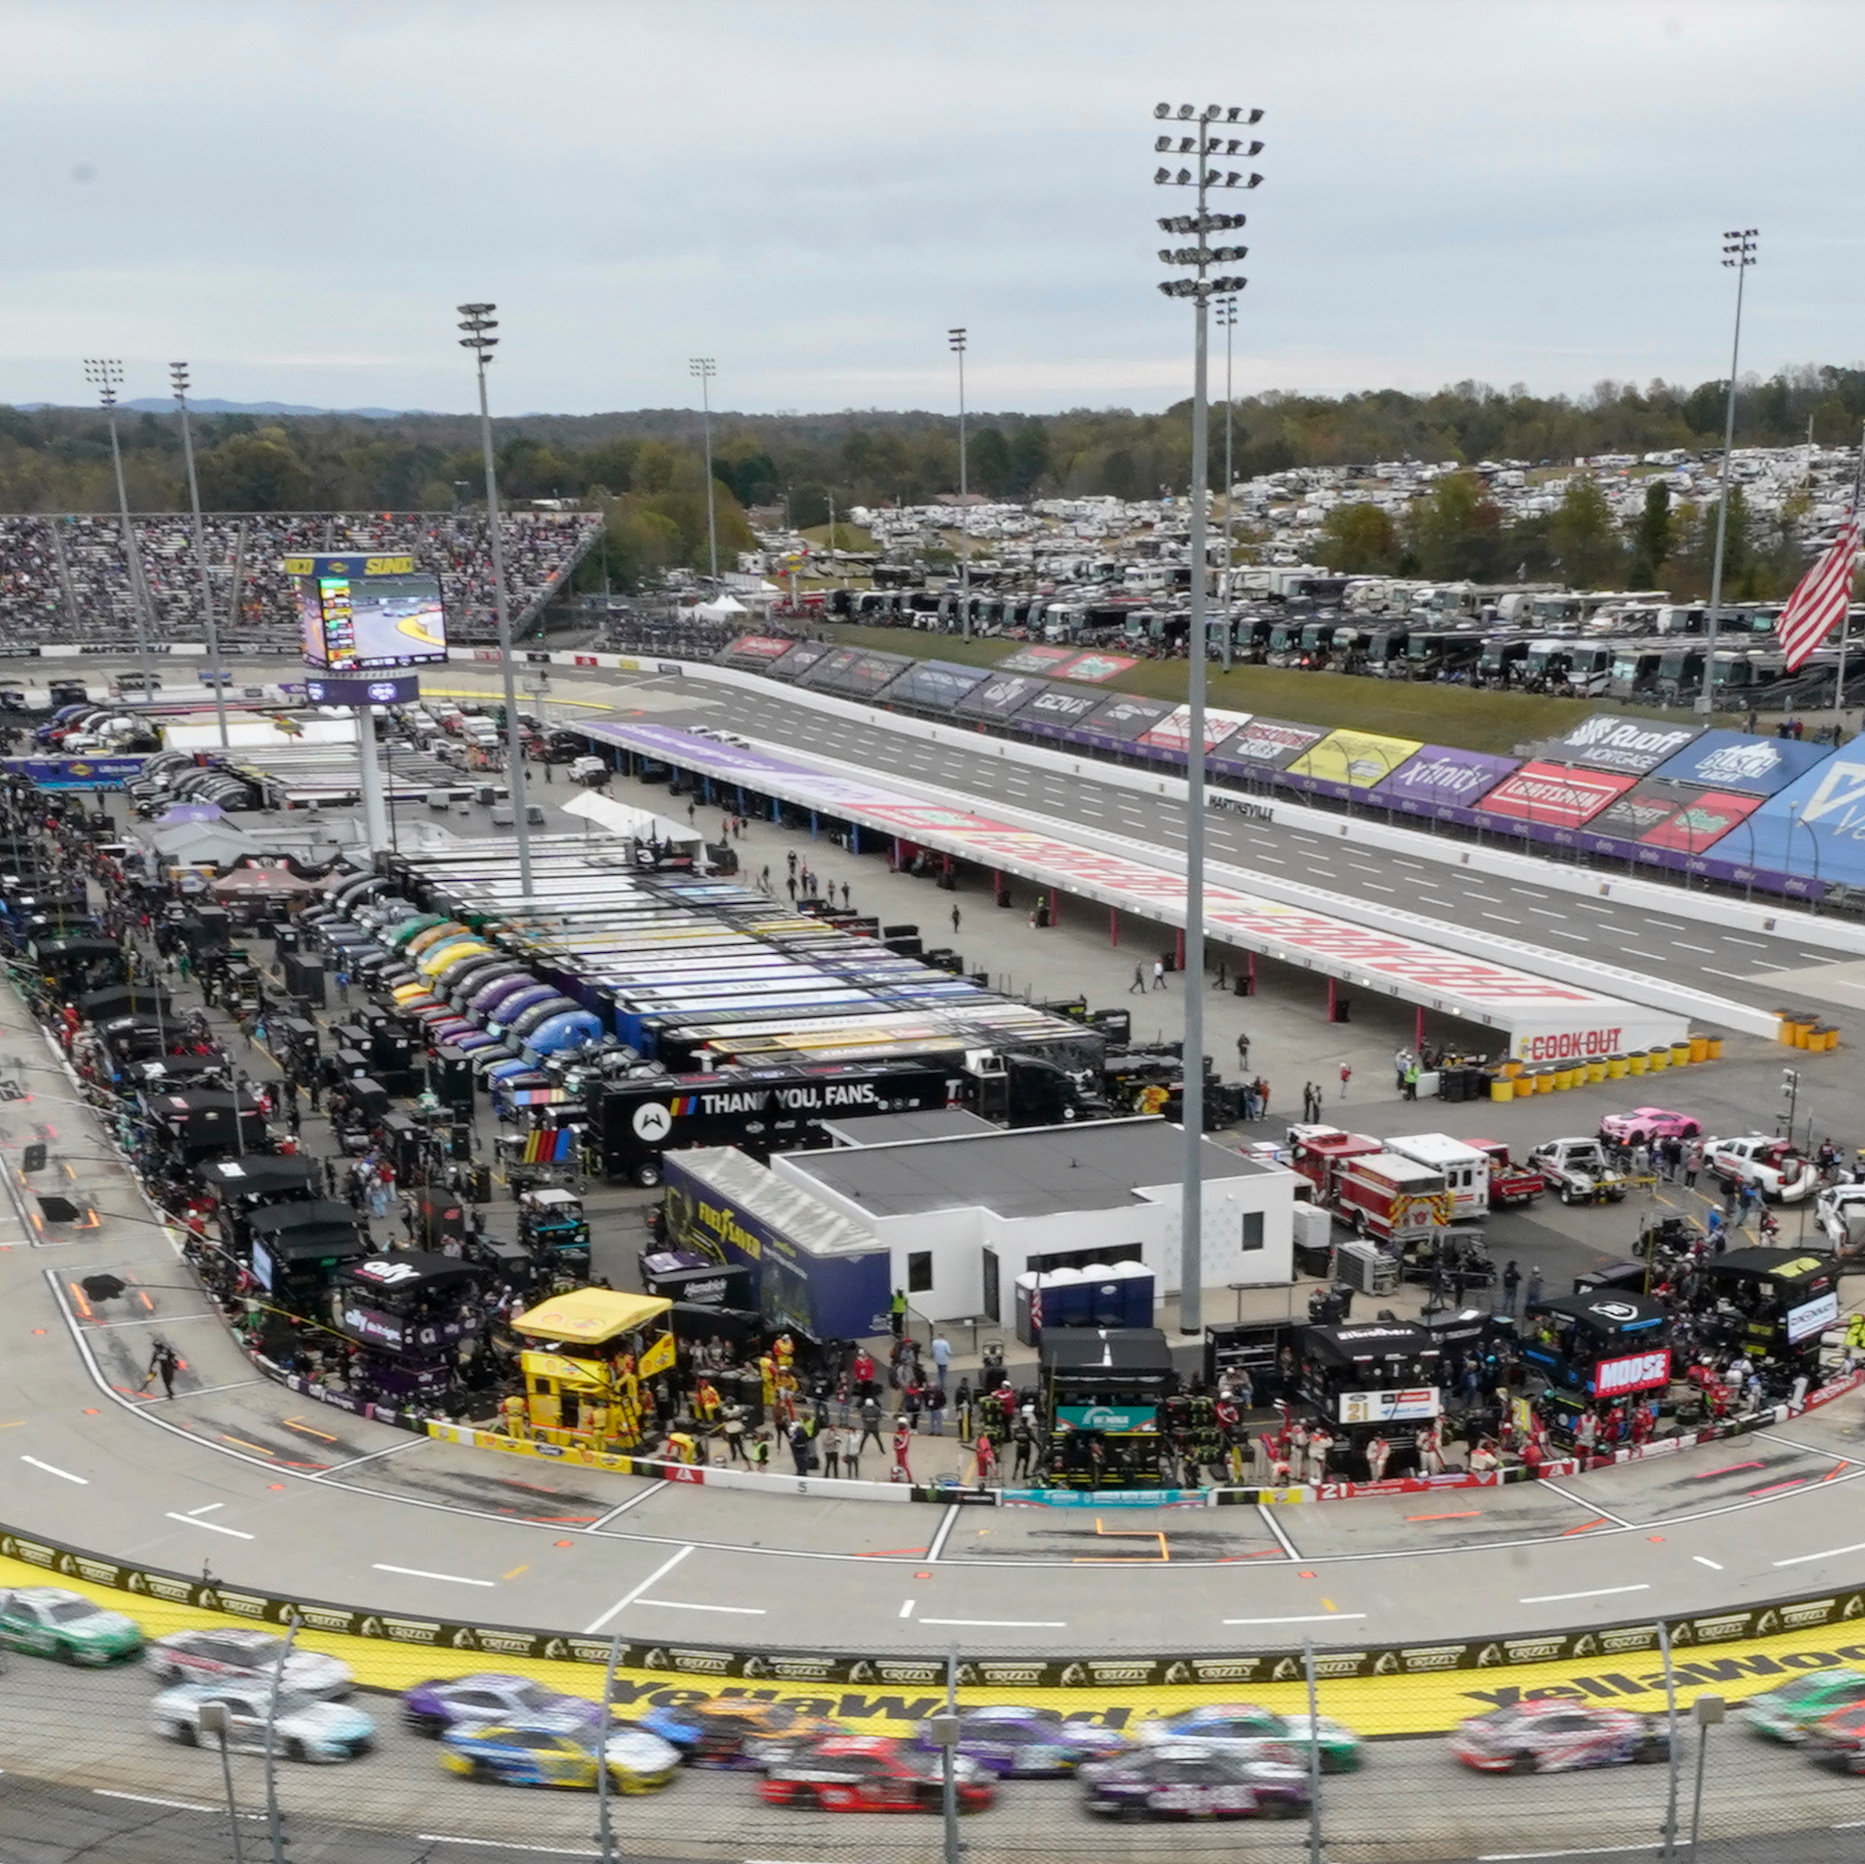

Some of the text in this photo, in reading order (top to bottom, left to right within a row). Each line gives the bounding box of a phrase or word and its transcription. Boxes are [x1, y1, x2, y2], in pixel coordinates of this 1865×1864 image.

[1601, 724, 1692, 753] Ruoff
[1580, 747, 1658, 769] MORTGAGE
[1399, 758, 1493, 794] xfinity
[1506, 780, 1602, 808] CRAFTSMAN
[1532, 1028, 1622, 1061] COOK OUT
[701, 1083, 879, 1114] THANK YOU, FANS.
[1599, 1354, 1668, 1393] MOOSE
[1348, 1403, 1369, 1421] 21
[1322, 1483, 1347, 1498] 21
[482, 1637, 531, 1652] GRIZZLY
[1603, 1633, 1654, 1649] GRIZZLY
[1509, 1644, 1559, 1658] GRIZZLY
[675, 1657, 728, 1671] GRIZZLY
[1406, 1653, 1459, 1667] GRIZZLY
[881, 1669, 935, 1681] GRIZZLY
[984, 1669, 1041, 1681] GRIZZLY
[1093, 1668, 1148, 1680] GRIZZLY
[1197, 1665, 1253, 1678] GRIZZLY
[1307, 1661, 1360, 1675] RIZZLY
